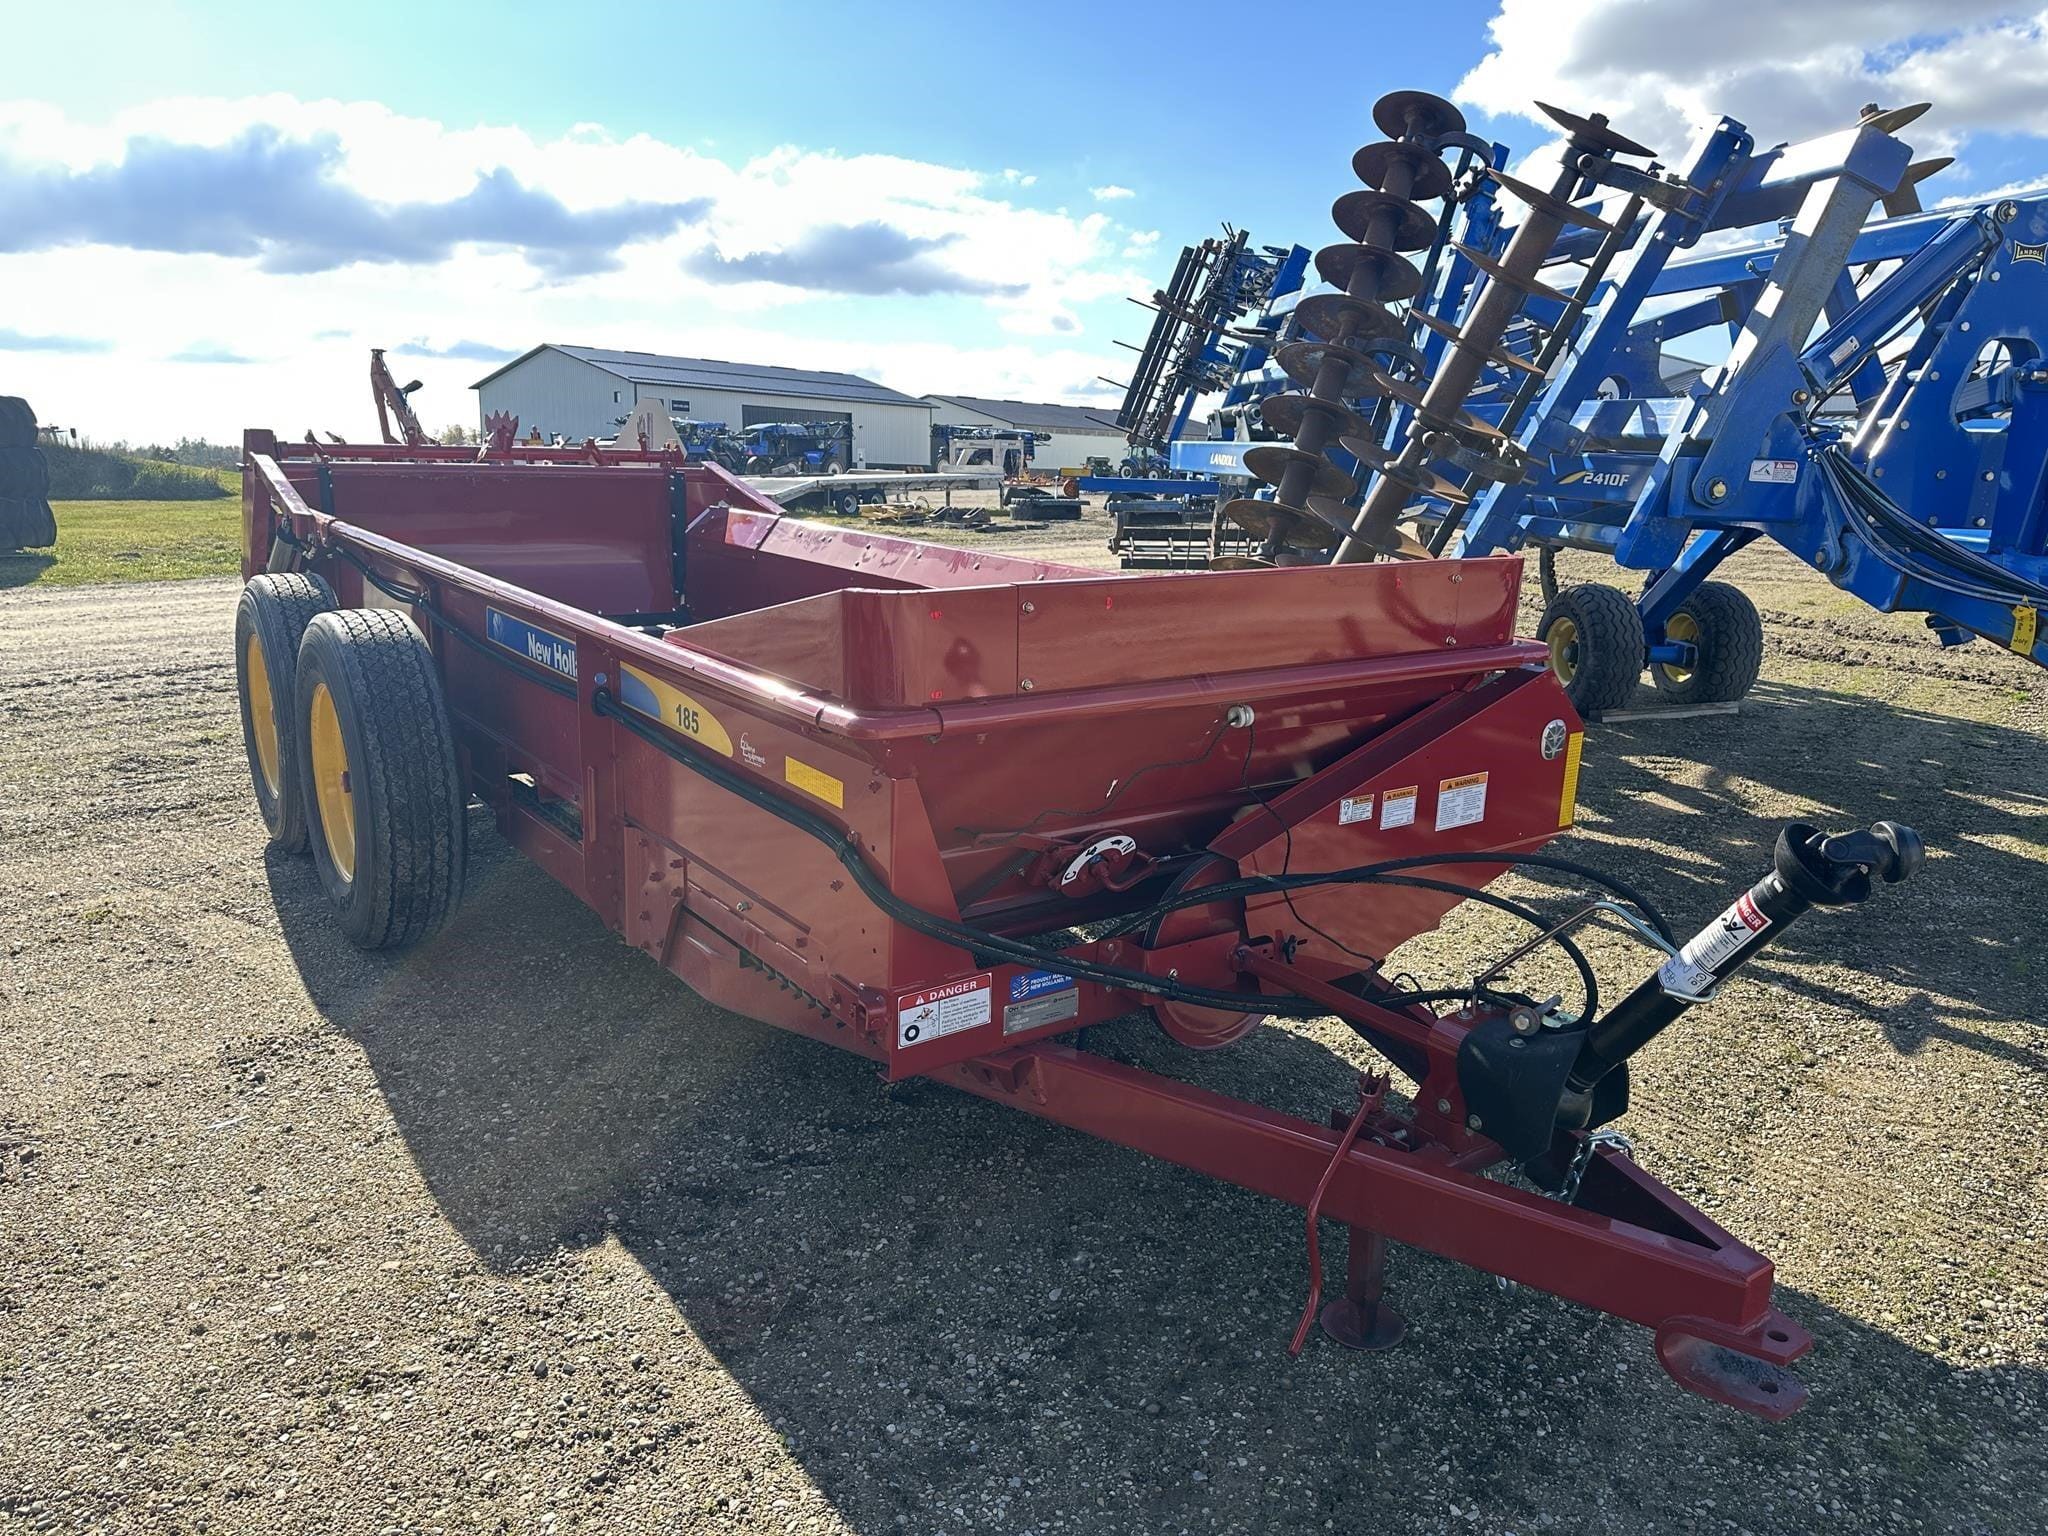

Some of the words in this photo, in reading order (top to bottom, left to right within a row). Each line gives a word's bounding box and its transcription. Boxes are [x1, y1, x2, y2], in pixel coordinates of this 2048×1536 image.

[1210, 453, 1237, 467] LANDOLL
[1583, 472, 1630, 487] 2410F
[527, 631, 551, 665] New
[553, 642, 578, 678] Holl
[675, 703, 699, 734] 185
[929, 980, 977, 1001] DANGER
